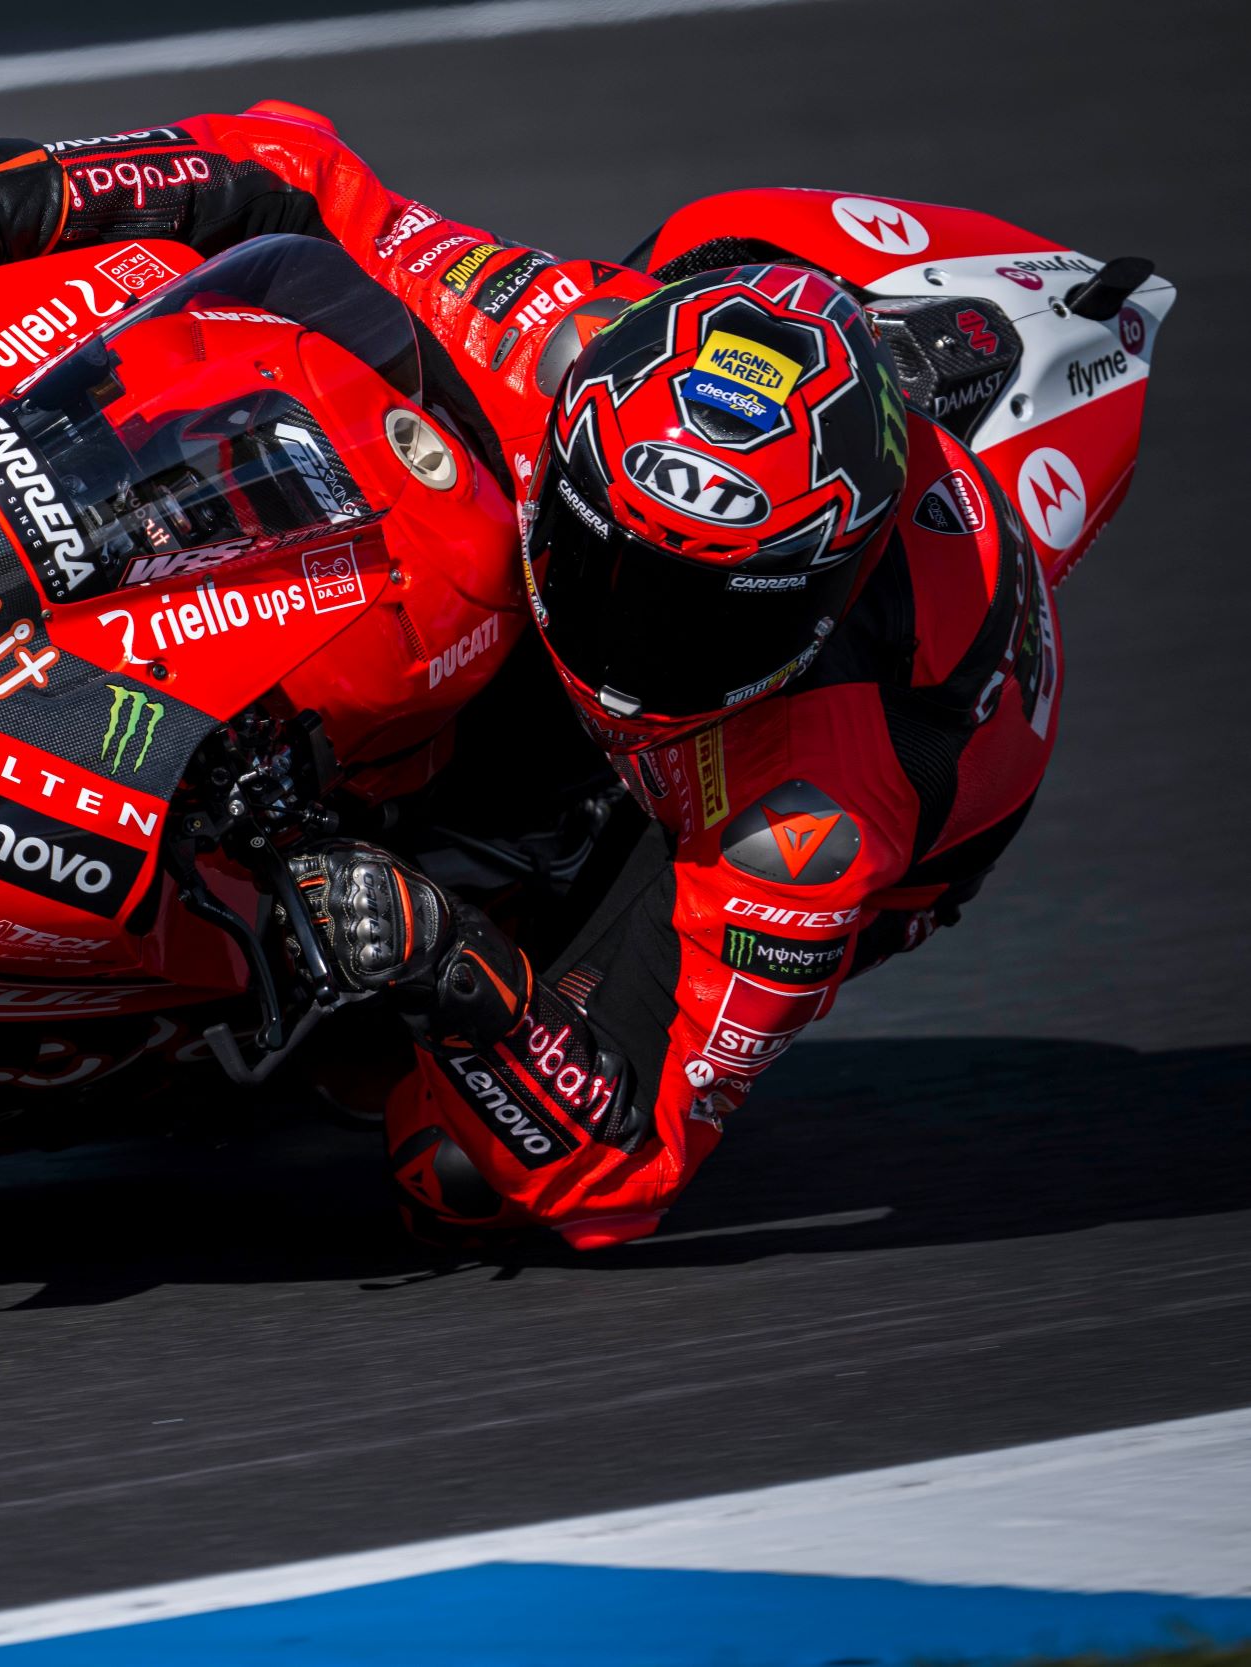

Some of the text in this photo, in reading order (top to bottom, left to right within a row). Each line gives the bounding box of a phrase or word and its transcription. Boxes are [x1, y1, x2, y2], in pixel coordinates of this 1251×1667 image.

[1122, 316, 1141, 345] to
[1066, 349, 1128, 398] flyme
[695, 382, 768, 416] checkstar
[633, 444, 759, 515] KYT
[950, 476, 980, 526] DUCATI
[558, 479, 609, 536] CARRERA
[7, 497, 41, 548] SINCE
[43, 559, 65, 598] 1956
[123, 538, 254, 585] WRS
[317, 582, 356, 600] DA_LIO
[730, 575, 807, 590] CARRERA
[150, 577, 305, 650] riello ups
[428, 613, 500, 690] DUCATI
[696, 728, 728, 820] IRELLI
[757, 943, 844, 966] MONSTER
[450, 1054, 553, 1156] Lenovo
